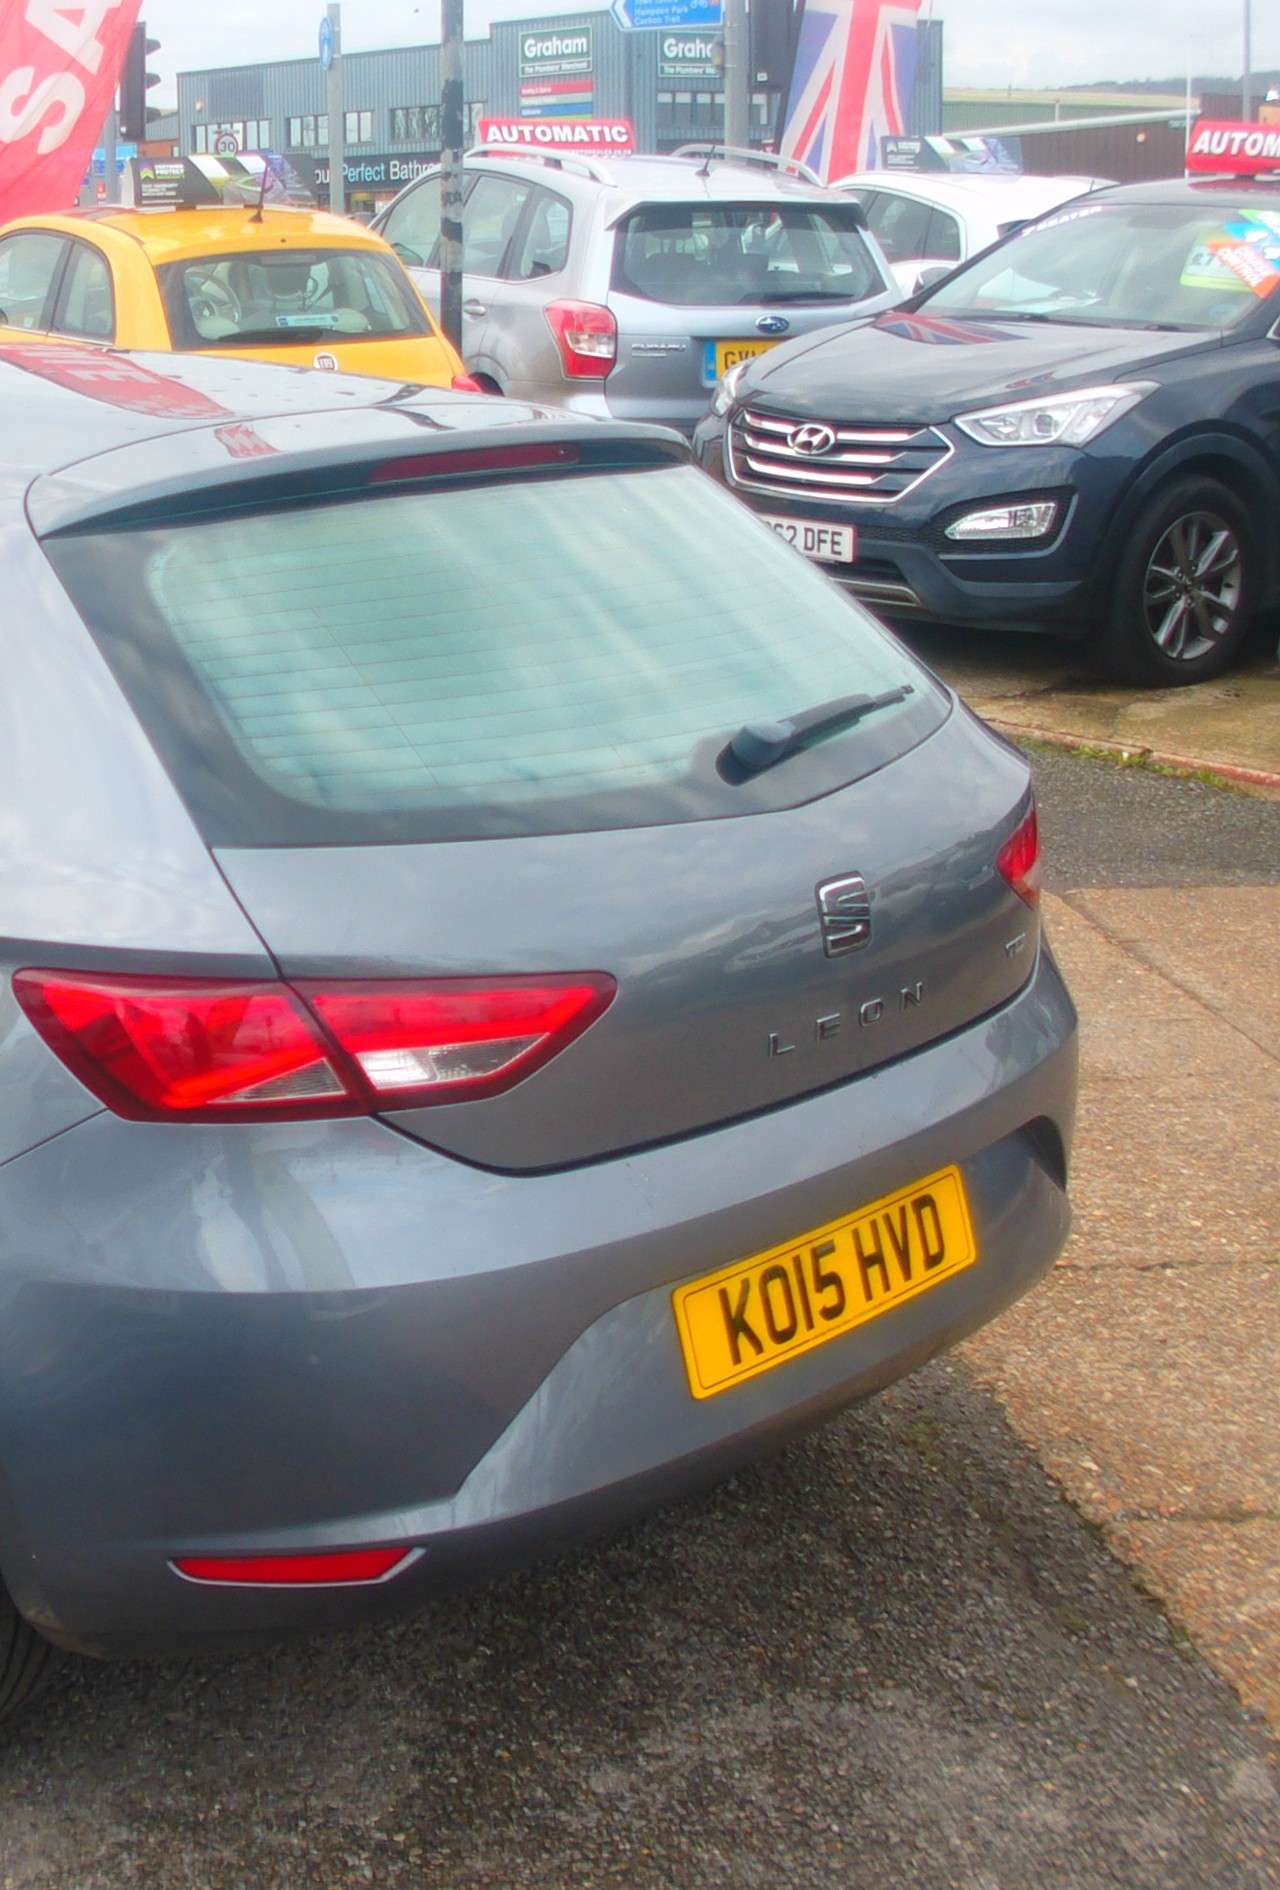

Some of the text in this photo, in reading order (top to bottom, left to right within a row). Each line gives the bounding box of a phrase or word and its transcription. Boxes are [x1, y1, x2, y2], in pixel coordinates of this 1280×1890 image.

[524, 36, 588, 58] Graham
[487, 124, 628, 144] AUTOMATIC
[220, 141, 235, 153] 30
[341, 162, 385, 183] Perfect
[803, 526, 843, 556] DFE
[769, 981, 923, 1057] LEON
[852, 1193, 946, 1303] HVD
